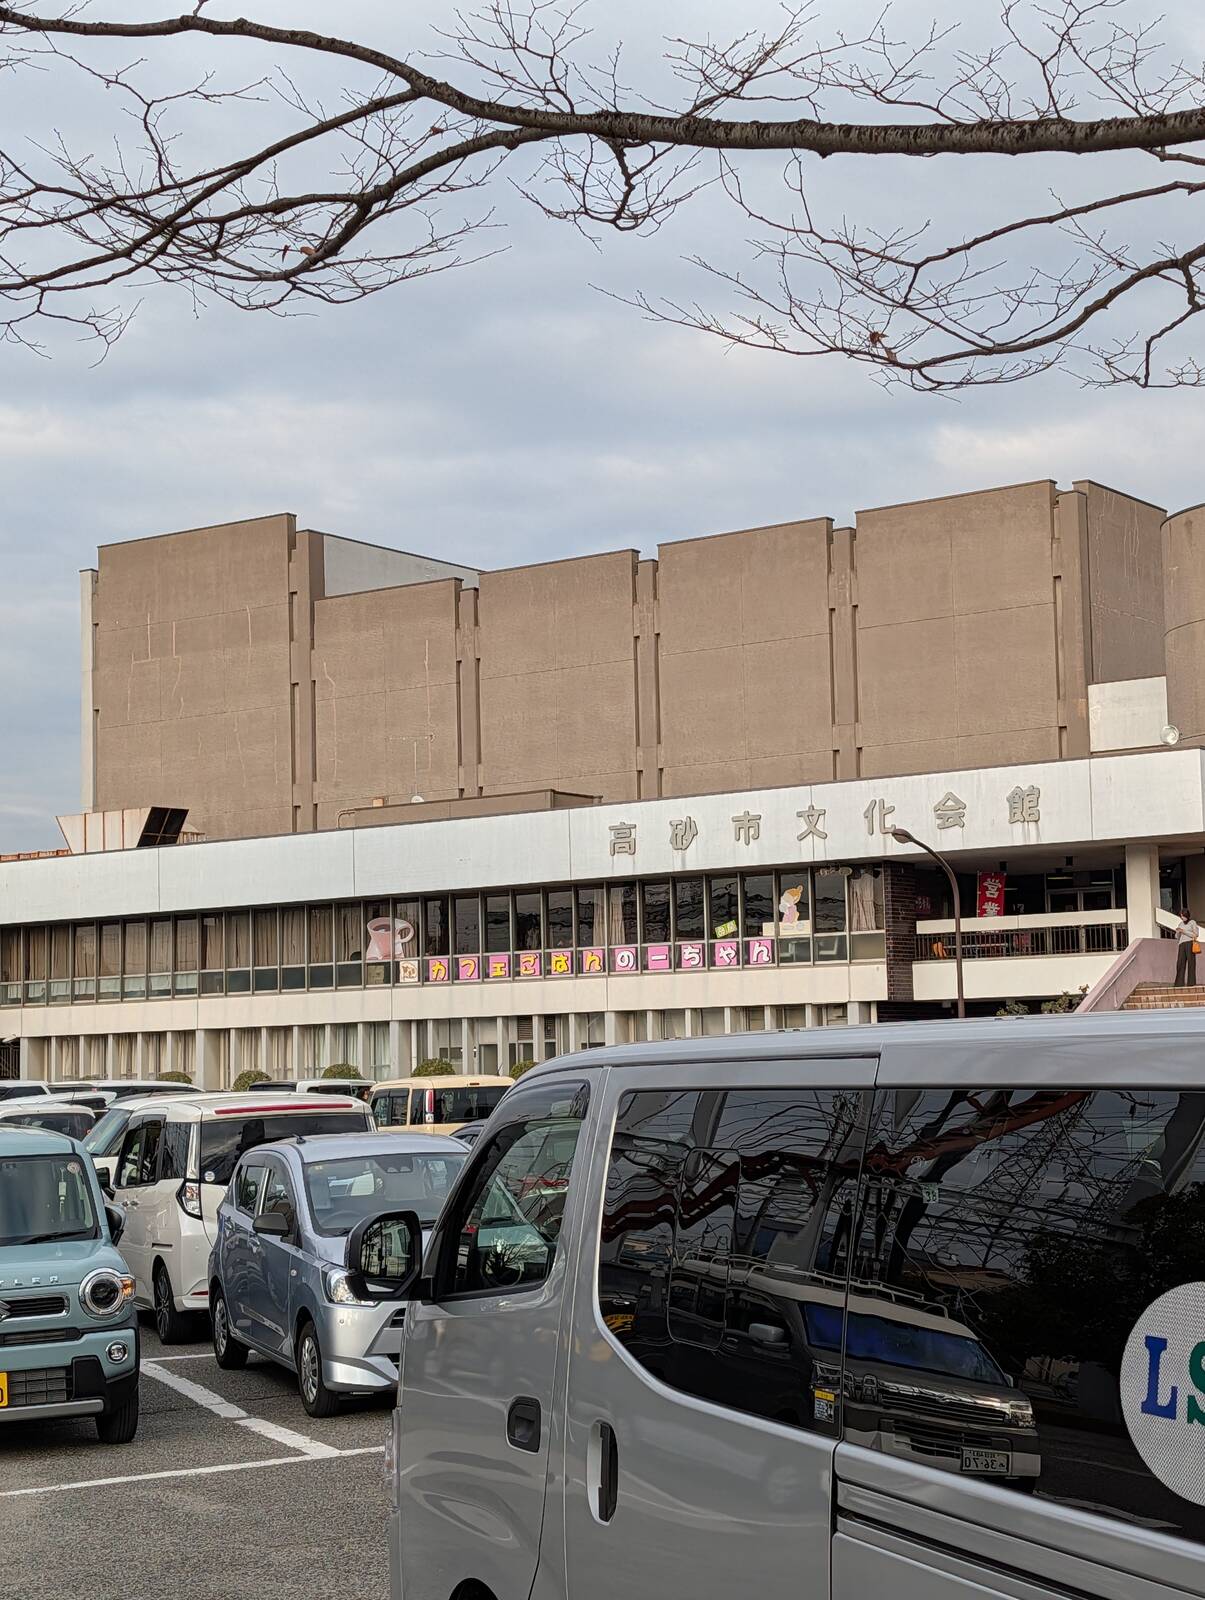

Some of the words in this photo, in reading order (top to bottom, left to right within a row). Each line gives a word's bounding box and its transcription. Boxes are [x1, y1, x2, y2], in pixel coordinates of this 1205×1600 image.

[608, 785, 1041, 856] 高砂市文化会館
